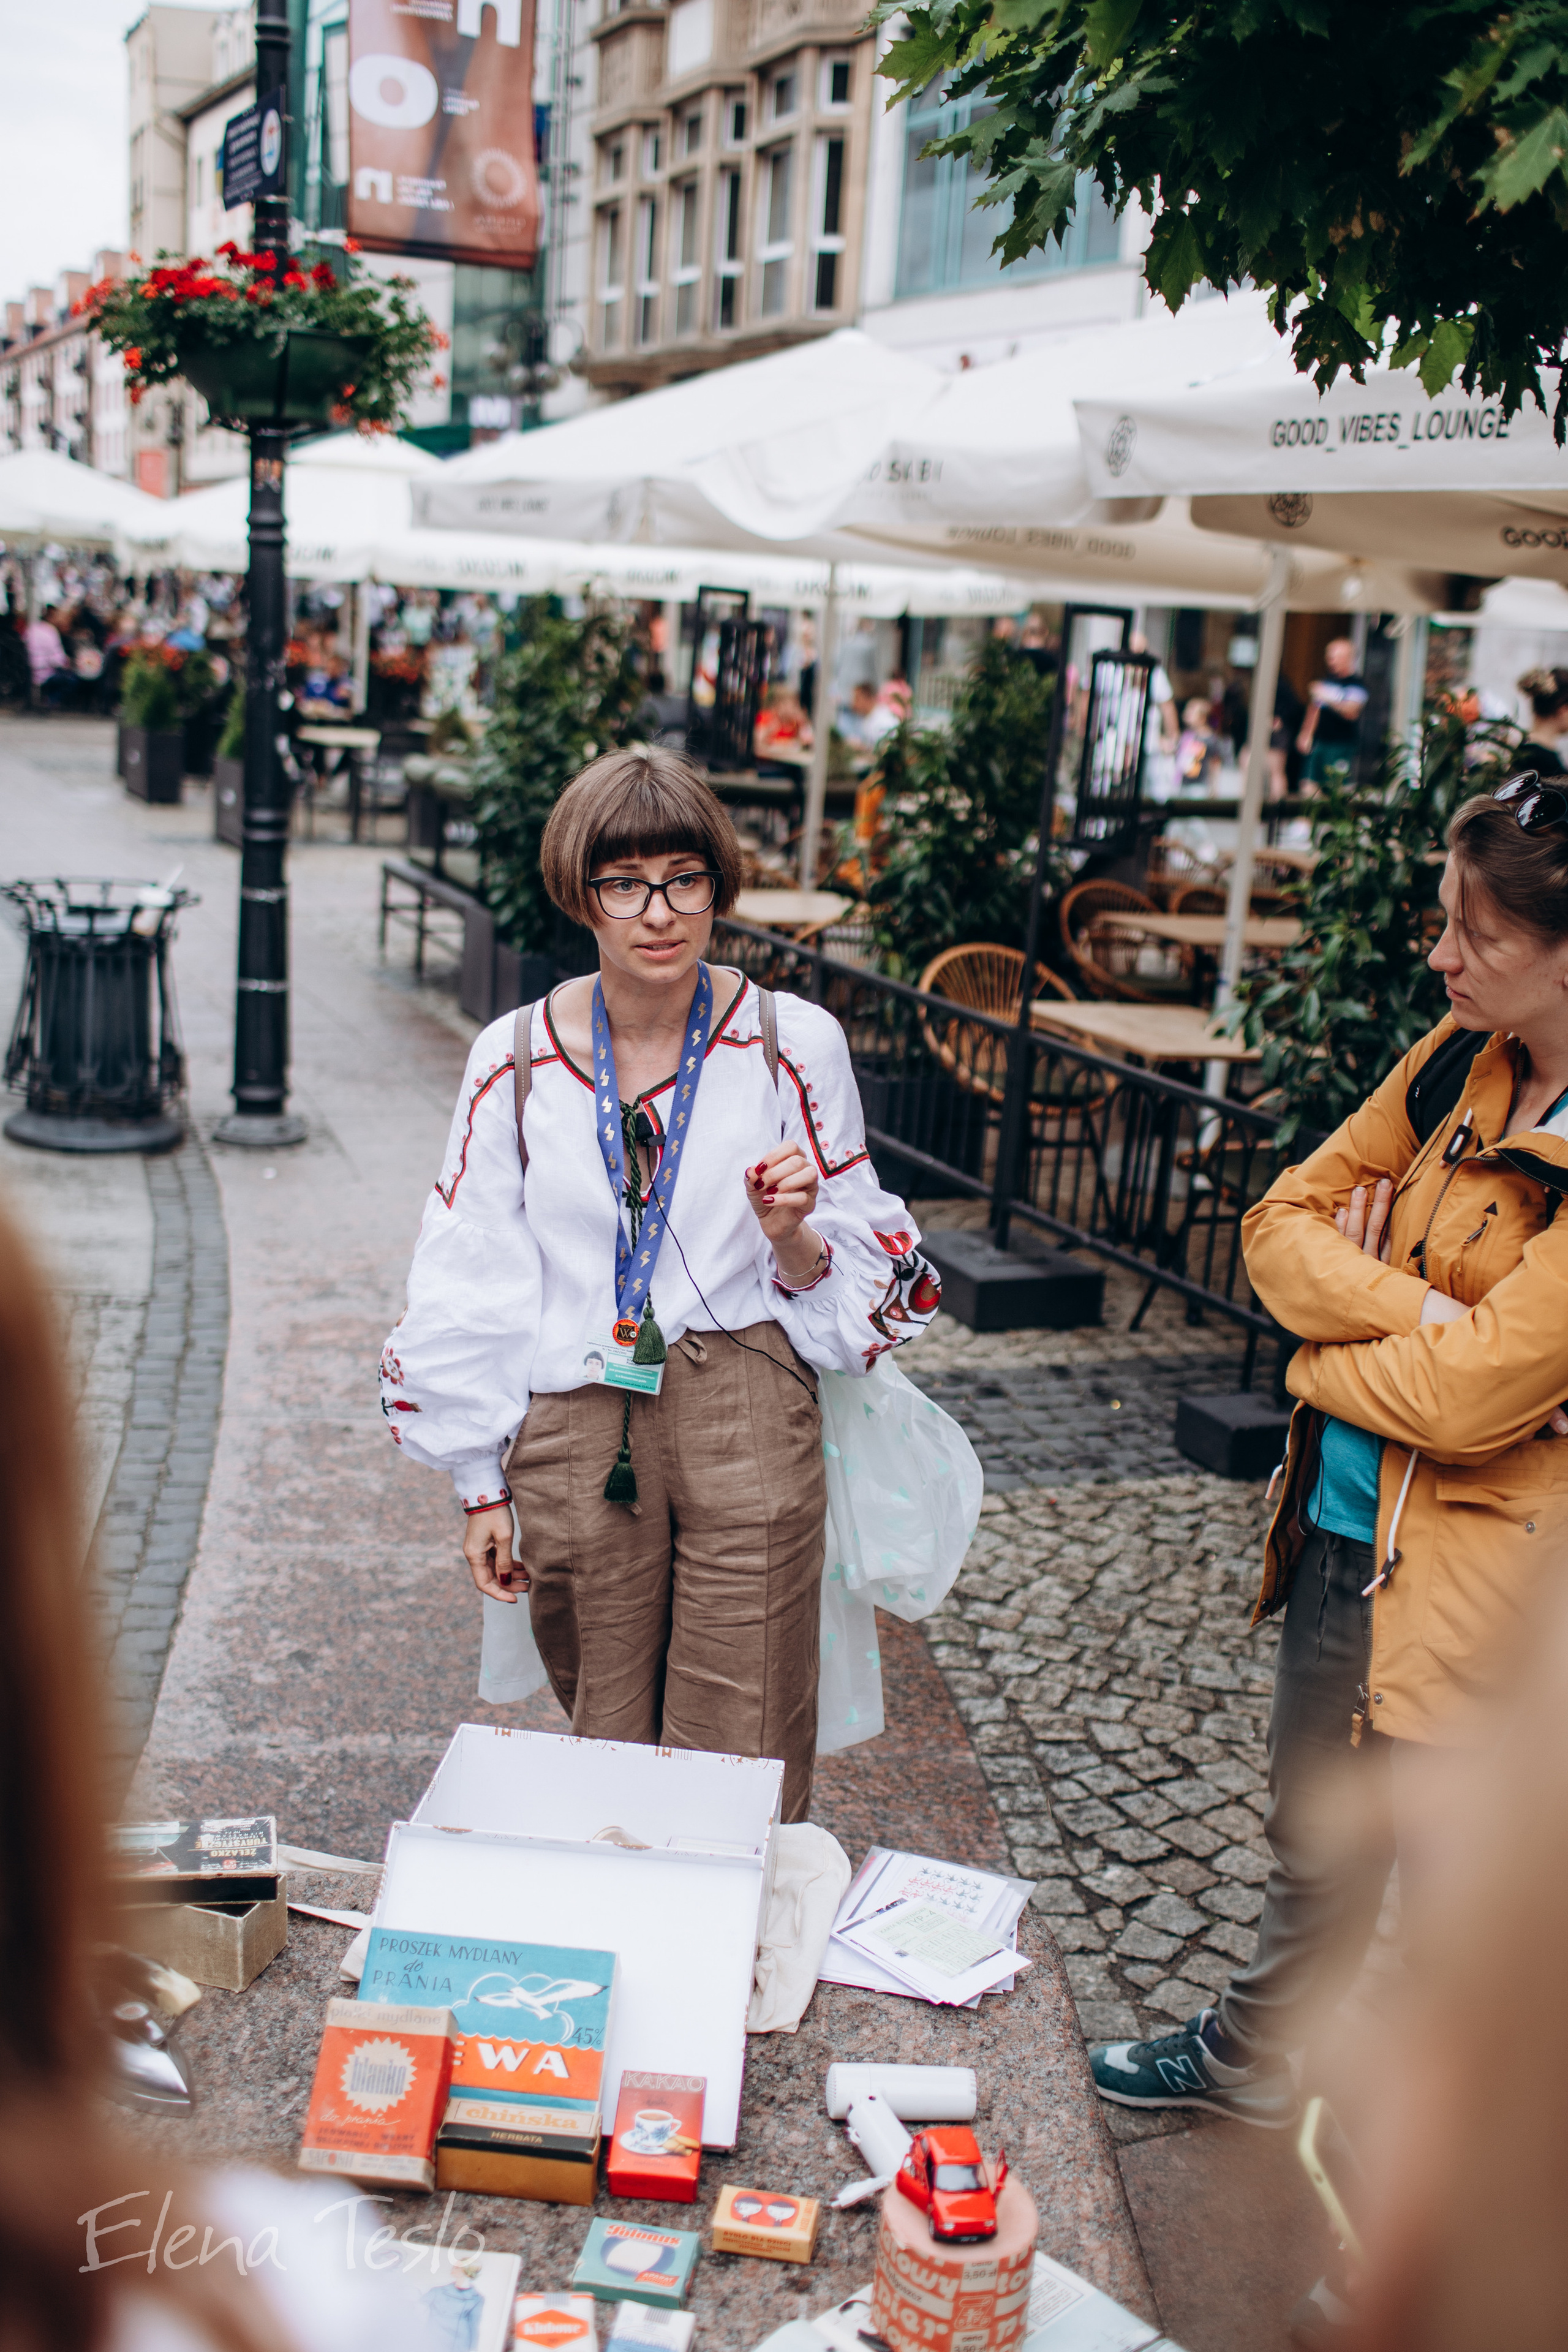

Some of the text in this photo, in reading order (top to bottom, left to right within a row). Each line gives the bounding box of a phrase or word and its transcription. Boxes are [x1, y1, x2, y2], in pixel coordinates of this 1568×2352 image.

[1270, 407, 1511, 452] GOOD_VIBES_LOUNGE
[211, 1848, 257, 1857] ŻELAZKO
[380, 1937, 522, 1965] PROSZEK MYDLANY
[404, 1959, 424, 1972] do
[372, 1970, 452, 1992] PRANIA
[377, 2010, 441, 2026] mydlane
[571, 2027, 605, 2045] 45%
[350, 2056, 407, 2095] blanko
[624, 2071, 704, 2092] KAKAO
[1155, 2054, 1207, 2092] N
[320, 2109, 339, 2122] do
[466, 2106, 579, 2130] chińska
[491, 2131, 543, 2144] HERBATA
[963, 2271, 986, 2280] 3,50
